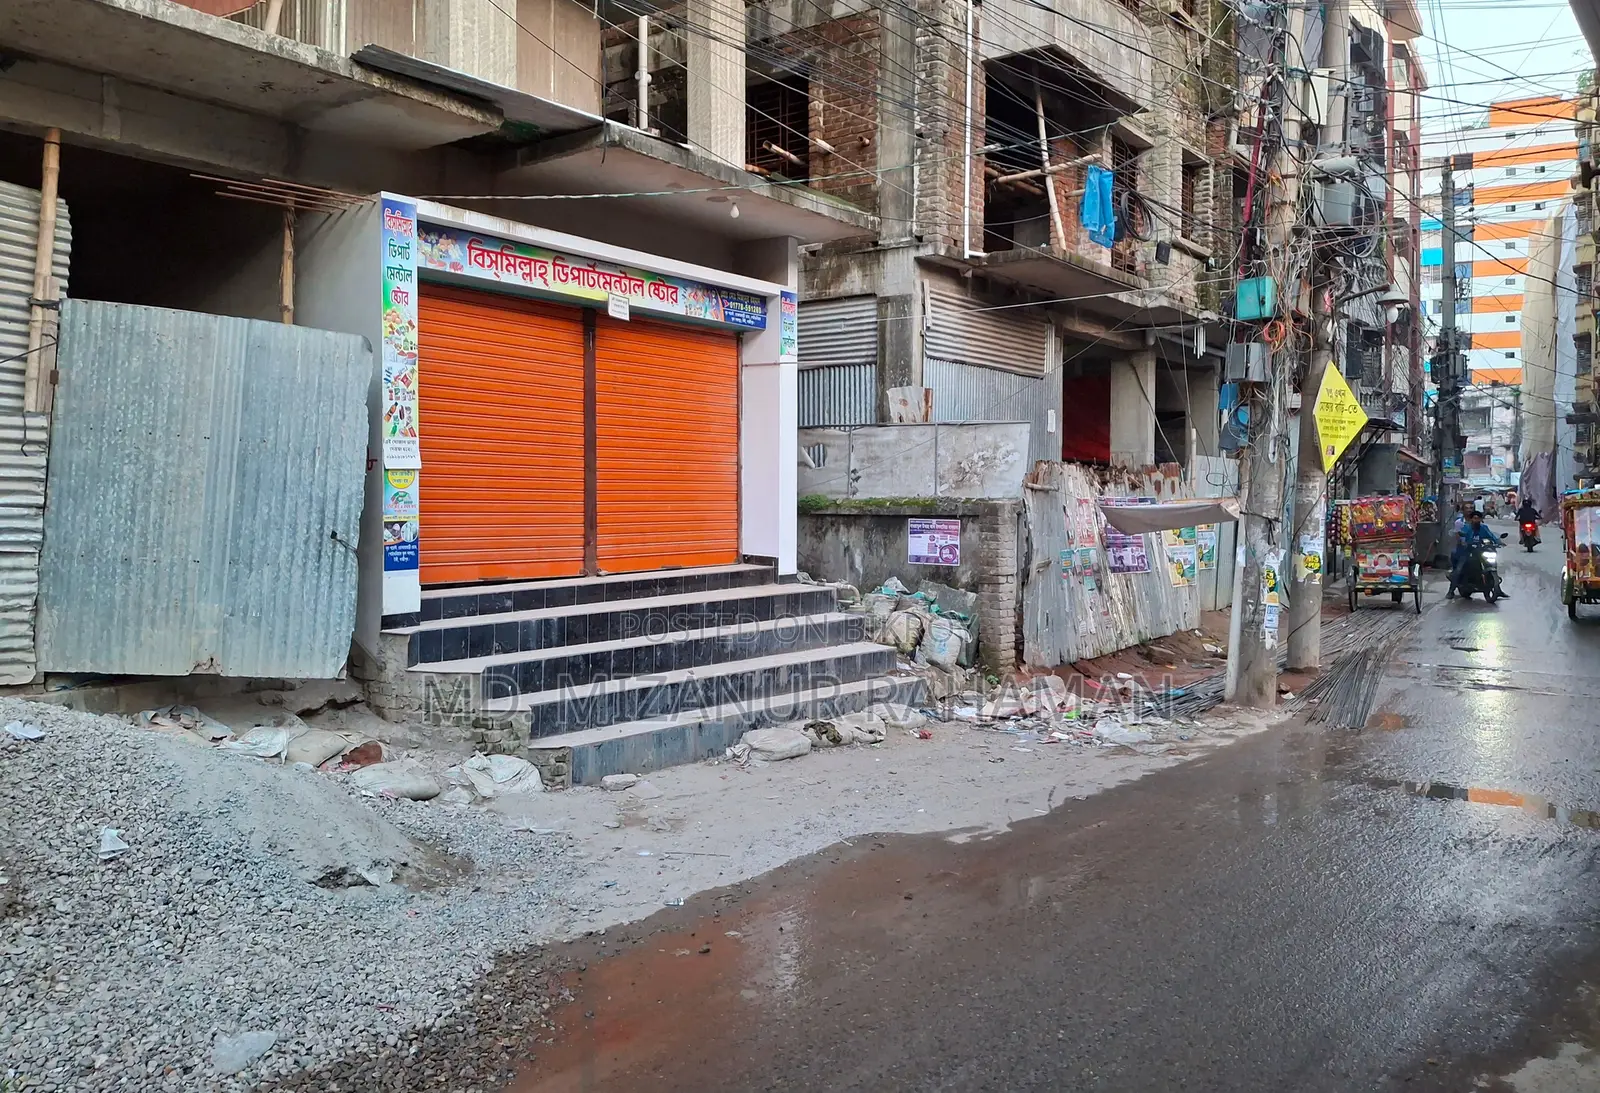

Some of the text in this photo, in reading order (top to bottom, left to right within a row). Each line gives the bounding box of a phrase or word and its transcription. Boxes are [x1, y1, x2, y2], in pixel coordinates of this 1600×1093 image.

[388, 238, 411, 260] ডিপার্ট
[386, 263, 413, 284] মেন্টাল
[551, 256, 645, 297] ডিপার্টমেন্টাল
